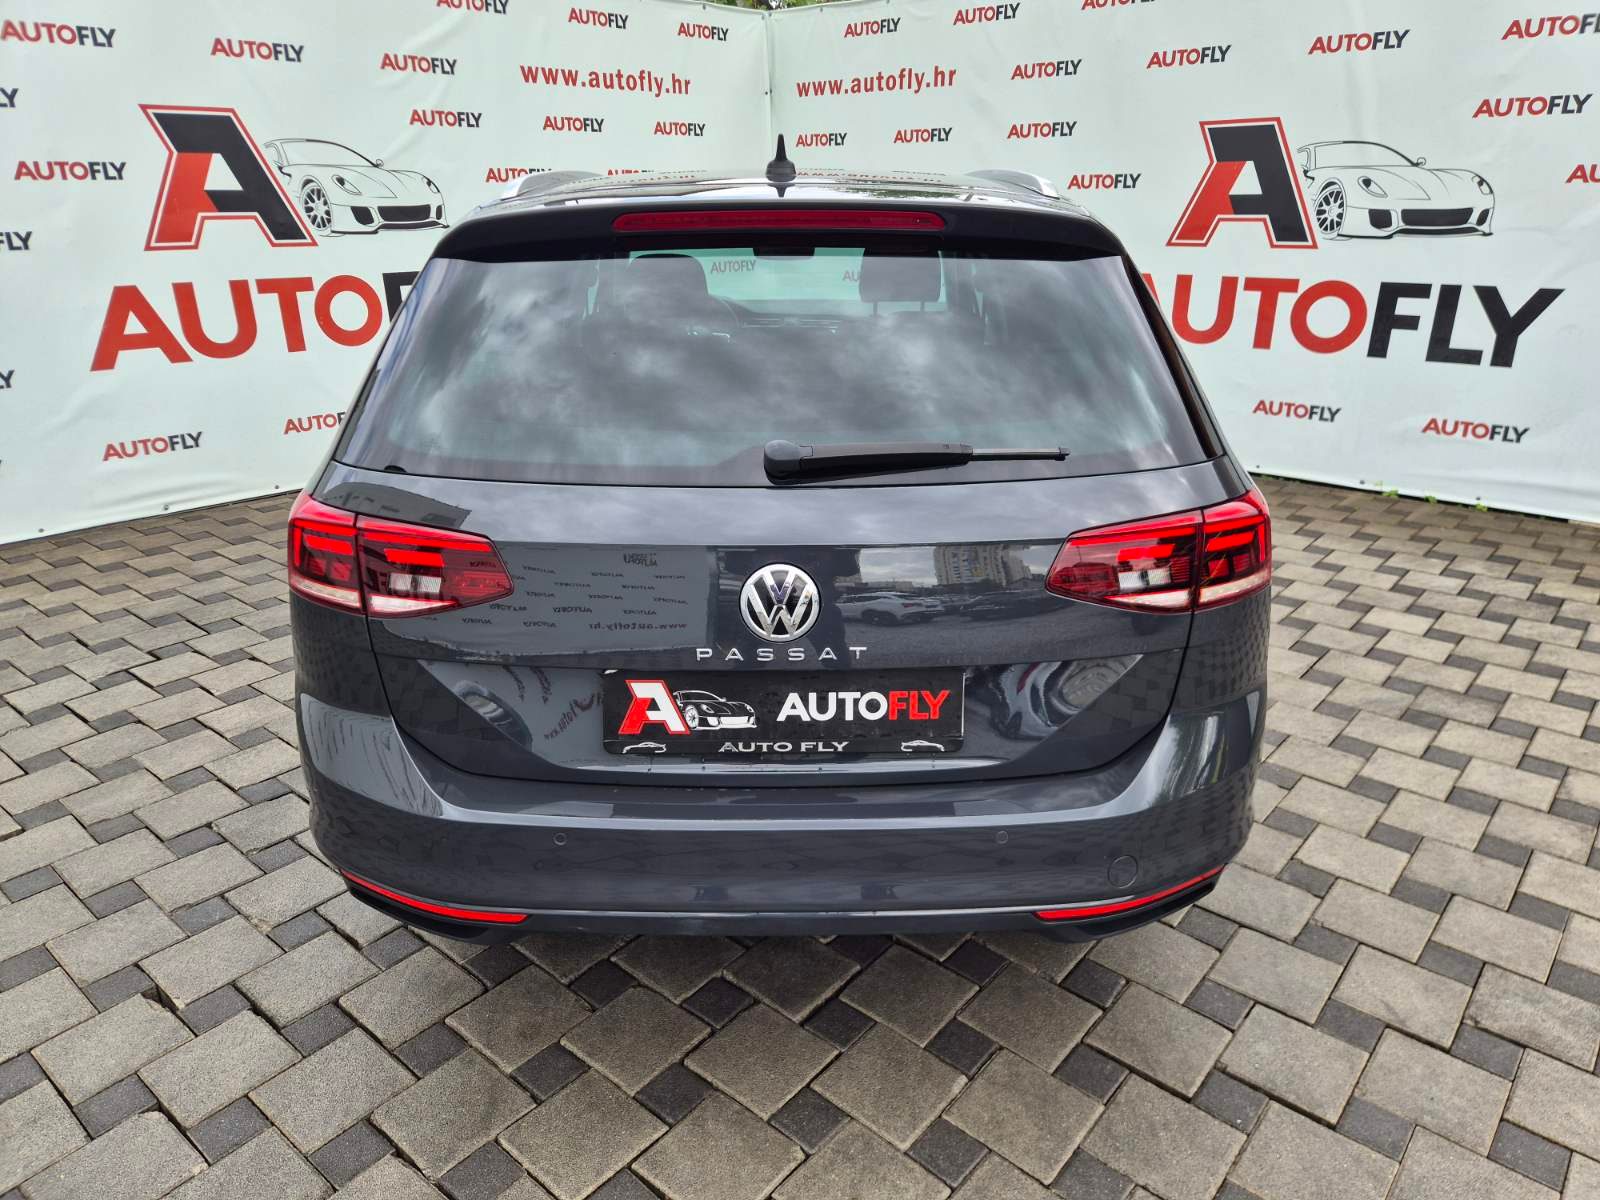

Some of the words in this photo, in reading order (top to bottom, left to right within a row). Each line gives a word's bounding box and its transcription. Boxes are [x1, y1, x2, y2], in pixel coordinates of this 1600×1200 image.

[568, 8, 629, 29] AUTOFLY
[953, 2, 1021, 26] AUTOFLY
[0, 20, 117, 48] AUTOFLY
[678, 22, 729, 41] AUTOFLY
[844, 17, 901, 38] AUTOFLY
[211, 38, 304, 62] AUTOFLY
[1308, 29, 1411, 55] AUTOFLY
[381, 53, 457, 75] AUTOFLY
[1146, 44, 1232, 69] AUTOFLY
[1011, 59, 1082, 80] AUTOFLY
[520, 64, 691, 98] www.autofly.hr
[796, 65, 957, 98] www.autofly.hr
[1472, 93, 1593, 119] AUTOFLY
[410, 109, 483, 128] AUTOFLY
[543, 116, 604, 133] AUTOFLY
[654, 121, 706, 137] AUTOFLY
[796, 132, 847, 147] AUTOFLY
[894, 127, 953, 144] AUTOFLY
[1007, 121, 1078, 140] AUTOFLY
[14, 160, 126, 181] AUTOFLY
[1068, 173, 1142, 190] AUTOFLY
[1140, 272, 1566, 368] UTOFLY
[1253, 400, 1342, 423] AUTOFLY
[1422, 417, 1530, 444] AUTOFLY
[103, 431, 203, 462] AUTOFLY
[696, 646, 867, 662] PASSAT
[776, 689, 951, 722] AUTOFLY
[718, 741, 793, 753] AUTO
[800, 741, 849, 752] FLY
